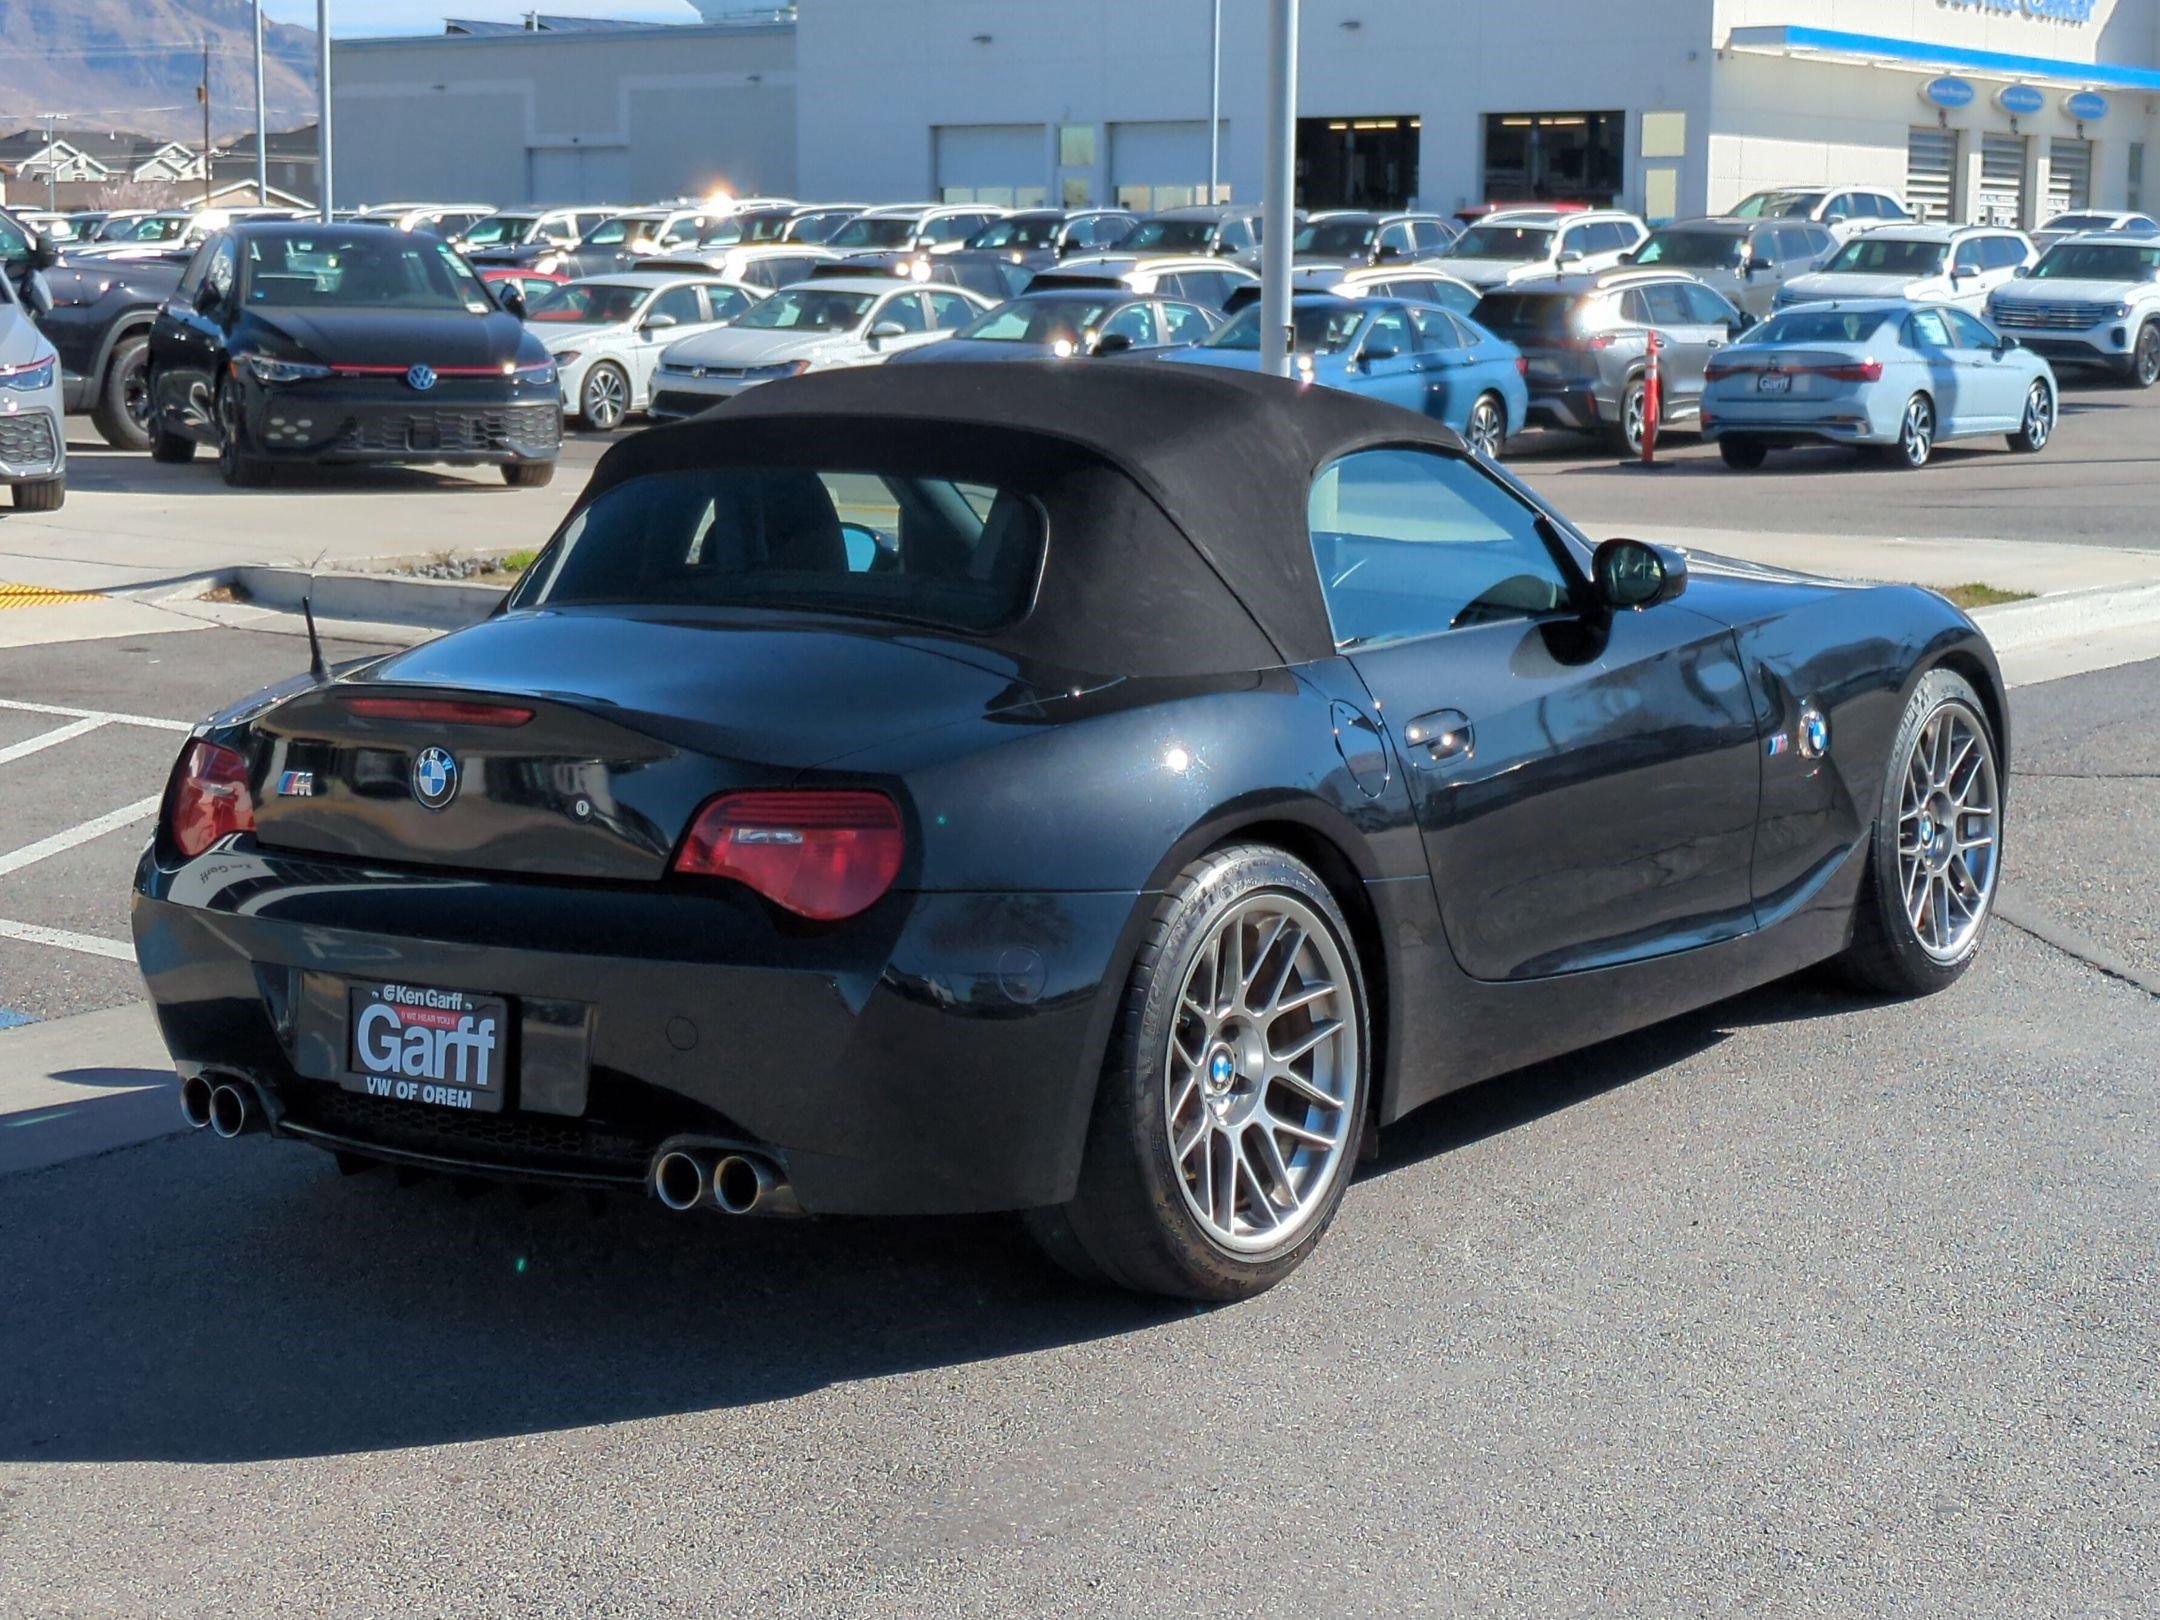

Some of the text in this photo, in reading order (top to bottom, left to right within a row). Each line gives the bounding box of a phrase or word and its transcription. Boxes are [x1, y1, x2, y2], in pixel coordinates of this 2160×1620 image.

[418, 1013, 436, 1023] HEAR
[436, 1016, 450, 1025] YOU
[357, 1003, 496, 1085] Garff
[366, 1076, 473, 1109] VW OF OREM
